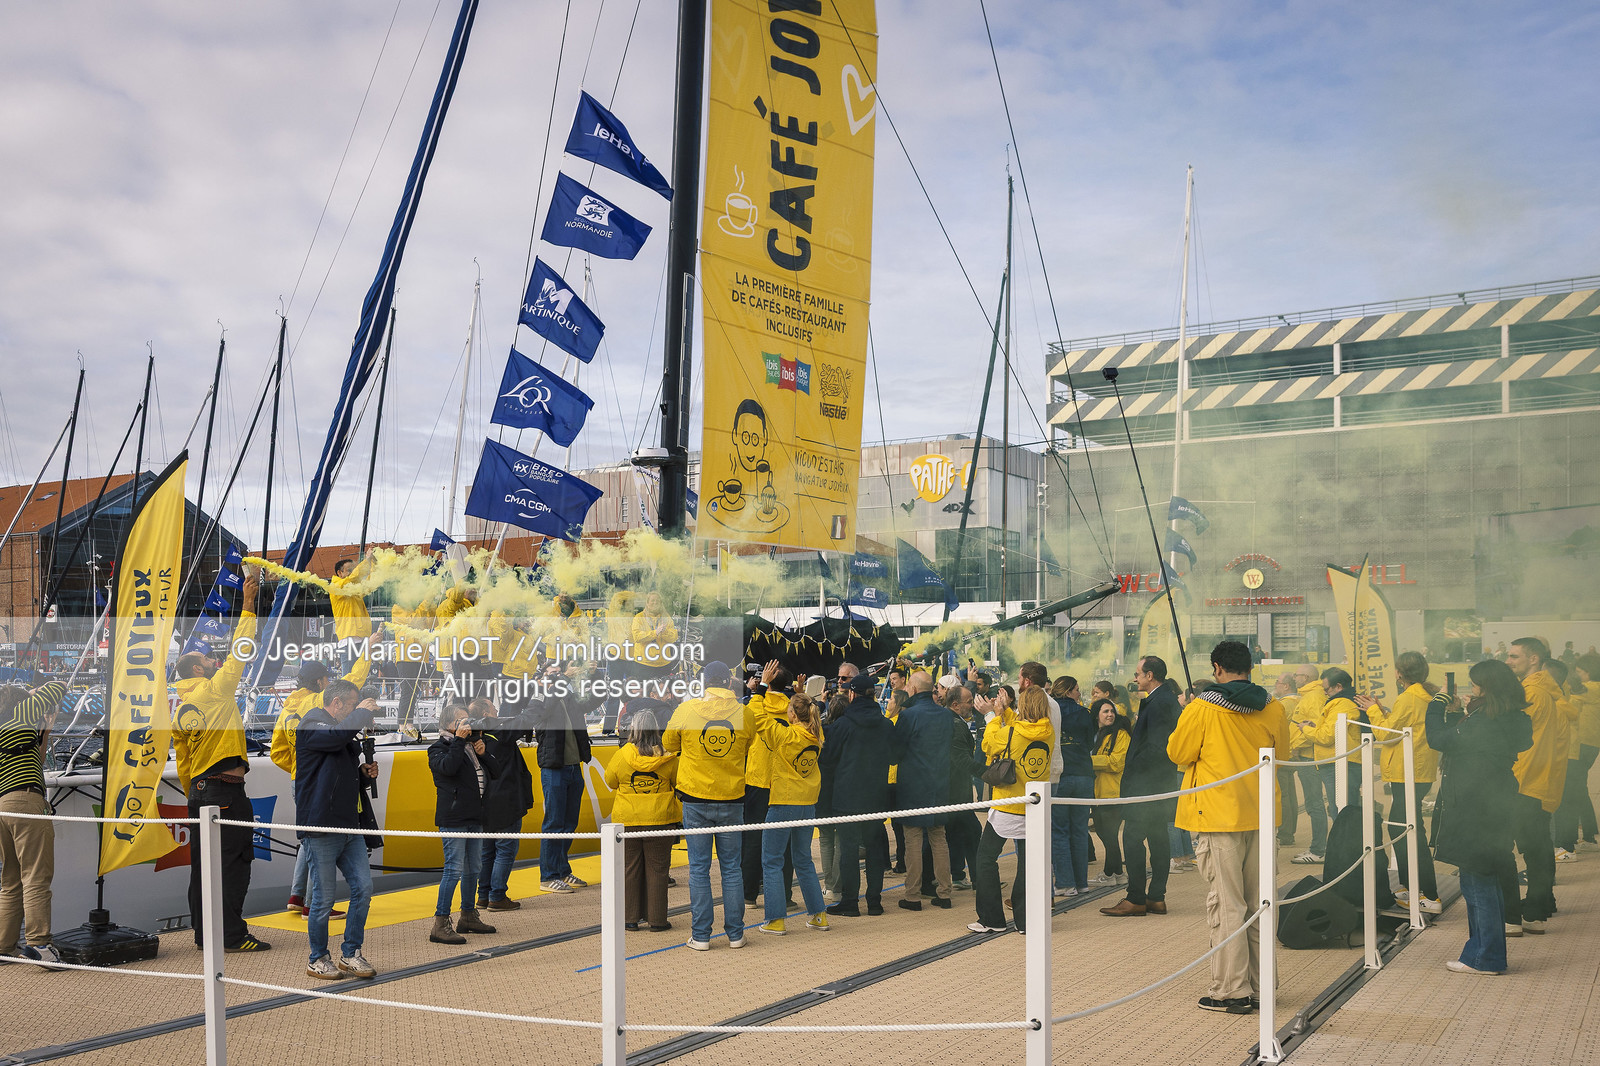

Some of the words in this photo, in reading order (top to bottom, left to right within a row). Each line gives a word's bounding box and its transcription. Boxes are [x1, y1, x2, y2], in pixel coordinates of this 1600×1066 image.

[753, 95, 818, 272] CAFÉ
[564, 221, 614, 238] NORMANDIE
[735, 272, 749, 287] LA
[752, 277, 801, 302] PREMIÈRE
[804, 294, 844, 315] FAMILLE
[731, 290, 746, 304] DE
[749, 296, 847, 333] CAFÉS-RESTAURANT
[766, 318, 813, 343] INCLUSIFS
[781, 366, 795, 381] ibis
[797, 367, 808, 379] ibis
[504, 494, 526, 506] CMA
[528, 500, 551, 514] CGM
[126, 568, 155, 681] JOYEUX
